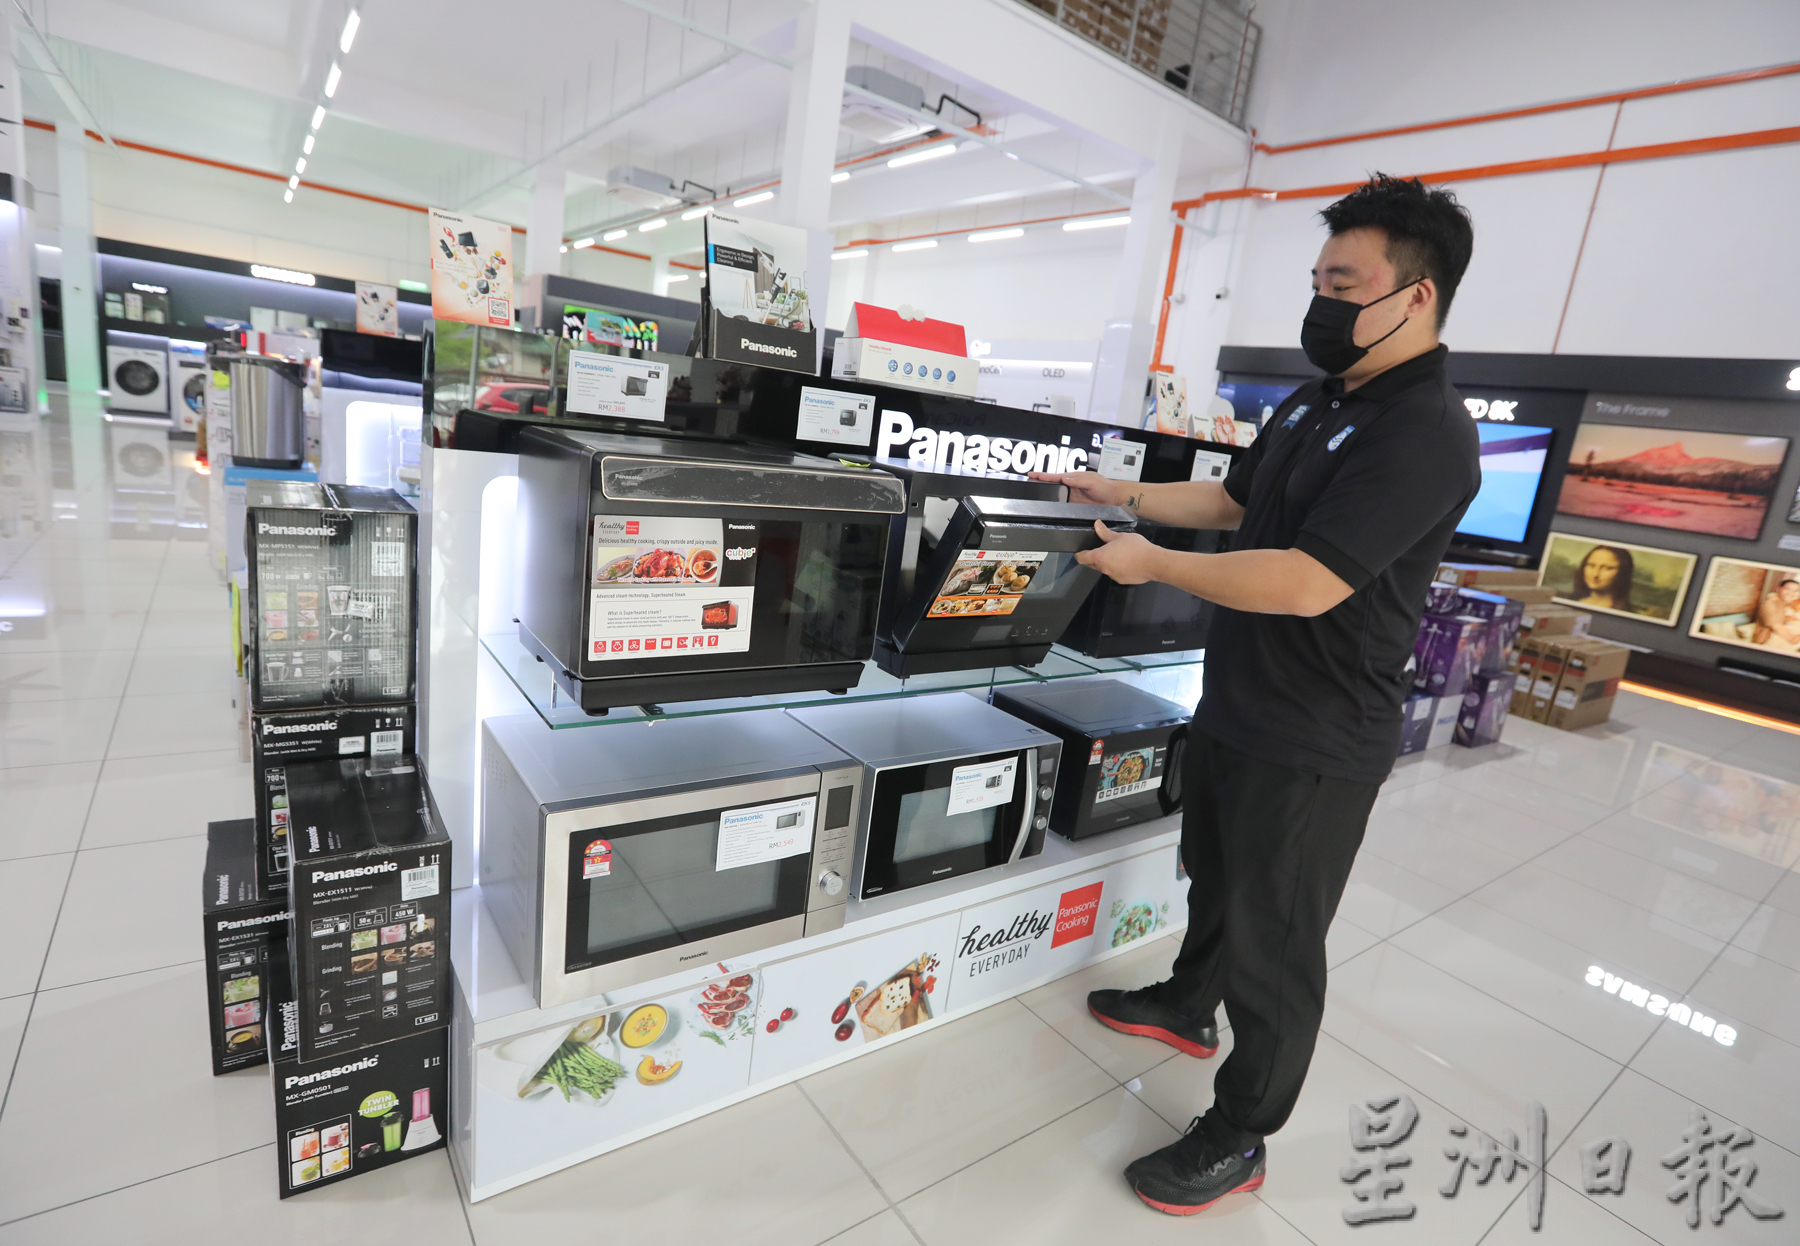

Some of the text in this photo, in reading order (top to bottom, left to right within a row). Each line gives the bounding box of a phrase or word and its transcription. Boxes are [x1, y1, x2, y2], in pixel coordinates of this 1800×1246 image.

[433, 211, 463, 223] Panasonic
[712, 213, 740, 224] Panasonic
[741, 338, 797, 358] Panasonic
[575, 361, 614, 373] Panasonic
[1042, 367, 1065, 378] OLED
[804, 396, 835, 406] Panasonic
[598, 403, 626, 413] RM2,388
[1488, 400, 1518, 421] 8K
[1622, 403, 1671, 417] Frame
[876, 409, 1088, 474] Panasonic
[258, 523, 336, 536] Panasonic
[598, 521, 626, 530] healthy
[263, 719, 338, 736] Panasonic
[263, 741, 299, 749] MX-MG5351
[955, 772, 982, 781] Panasonic
[724, 813, 764, 825] Panasonic
[306, 826, 320, 853] Panasonic
[768, 839, 794, 850] RM2,549
[312, 861, 398, 884] Panasonic
[932, 867, 952, 875] Panasonic
[215, 874, 229, 906] Panasonic
[313, 887, 352, 899] MX-EX1511
[1058, 898, 1098, 919] Panasonic
[217, 911, 295, 932] Panasonic
[1056, 915, 1089, 933] Cooking
[219, 932, 254, 944] MX-EX1531
[958, 909, 1054, 959] healthy
[321, 942, 343, 951] Blending
[679, 951, 709, 962] Panasonic
[969, 943, 1030, 978] EVERYDAY
[230, 971, 252, 980] Blending
[321, 966, 343, 975] Grinding
[278, 1001, 297, 1052] Panasonic
[285, 1056, 379, 1090] Panasonic
[285, 1084, 332, 1101] MX-GM0501
[357, 1099, 400, 1116] TUMBLER
[366, 1095, 392, 1108] TWIN
[295, 1127, 315, 1137] Blending
